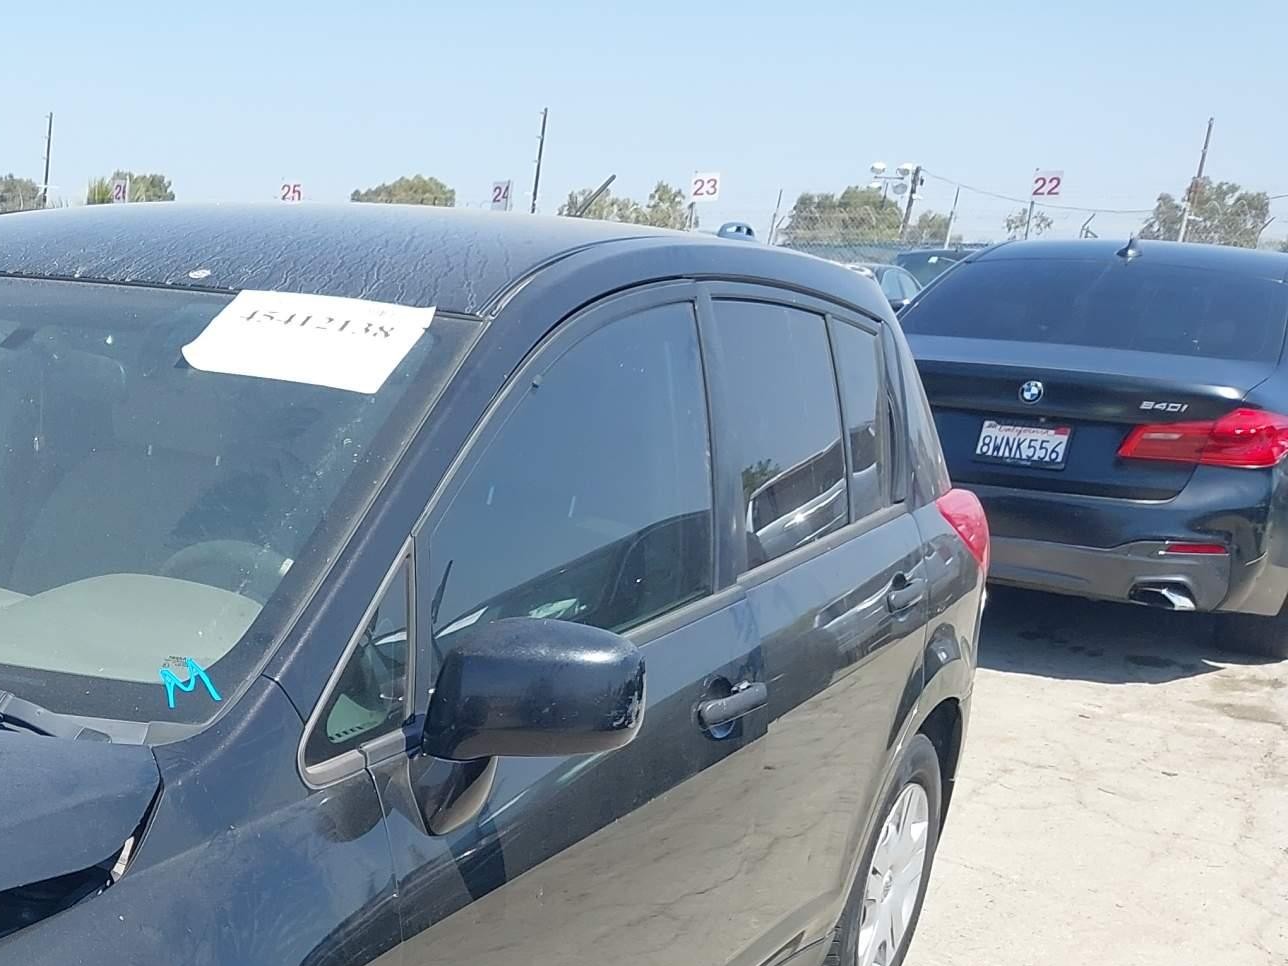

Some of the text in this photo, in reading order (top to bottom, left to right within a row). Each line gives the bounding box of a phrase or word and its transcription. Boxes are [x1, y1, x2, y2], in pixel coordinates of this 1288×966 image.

[280, 184, 302, 201] 25
[492, 185, 510, 203] 24
[693, 178, 718, 196] 23
[1032, 176, 1062, 196] 22
[238, 309, 398, 342] 45412138
[979, 434, 1063, 462] 8WNK556
[159, 657, 221, 709] M
